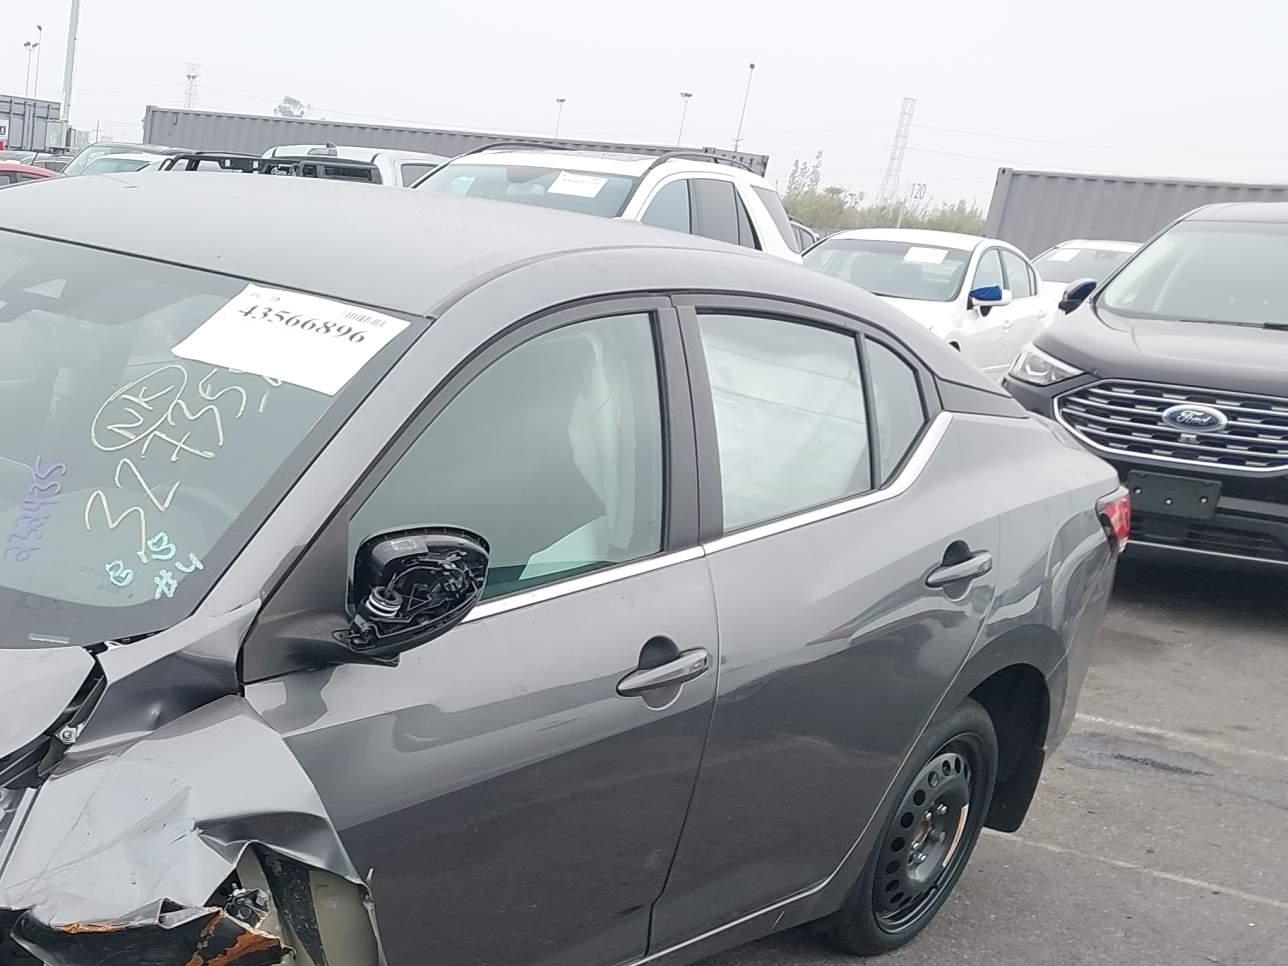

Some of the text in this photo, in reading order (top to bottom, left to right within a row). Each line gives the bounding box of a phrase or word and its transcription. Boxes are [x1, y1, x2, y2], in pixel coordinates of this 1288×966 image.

[910, 183, 927, 200] 120
[239, 304, 369, 344] 43566896
[1176, 410, 1212, 425] Ford
